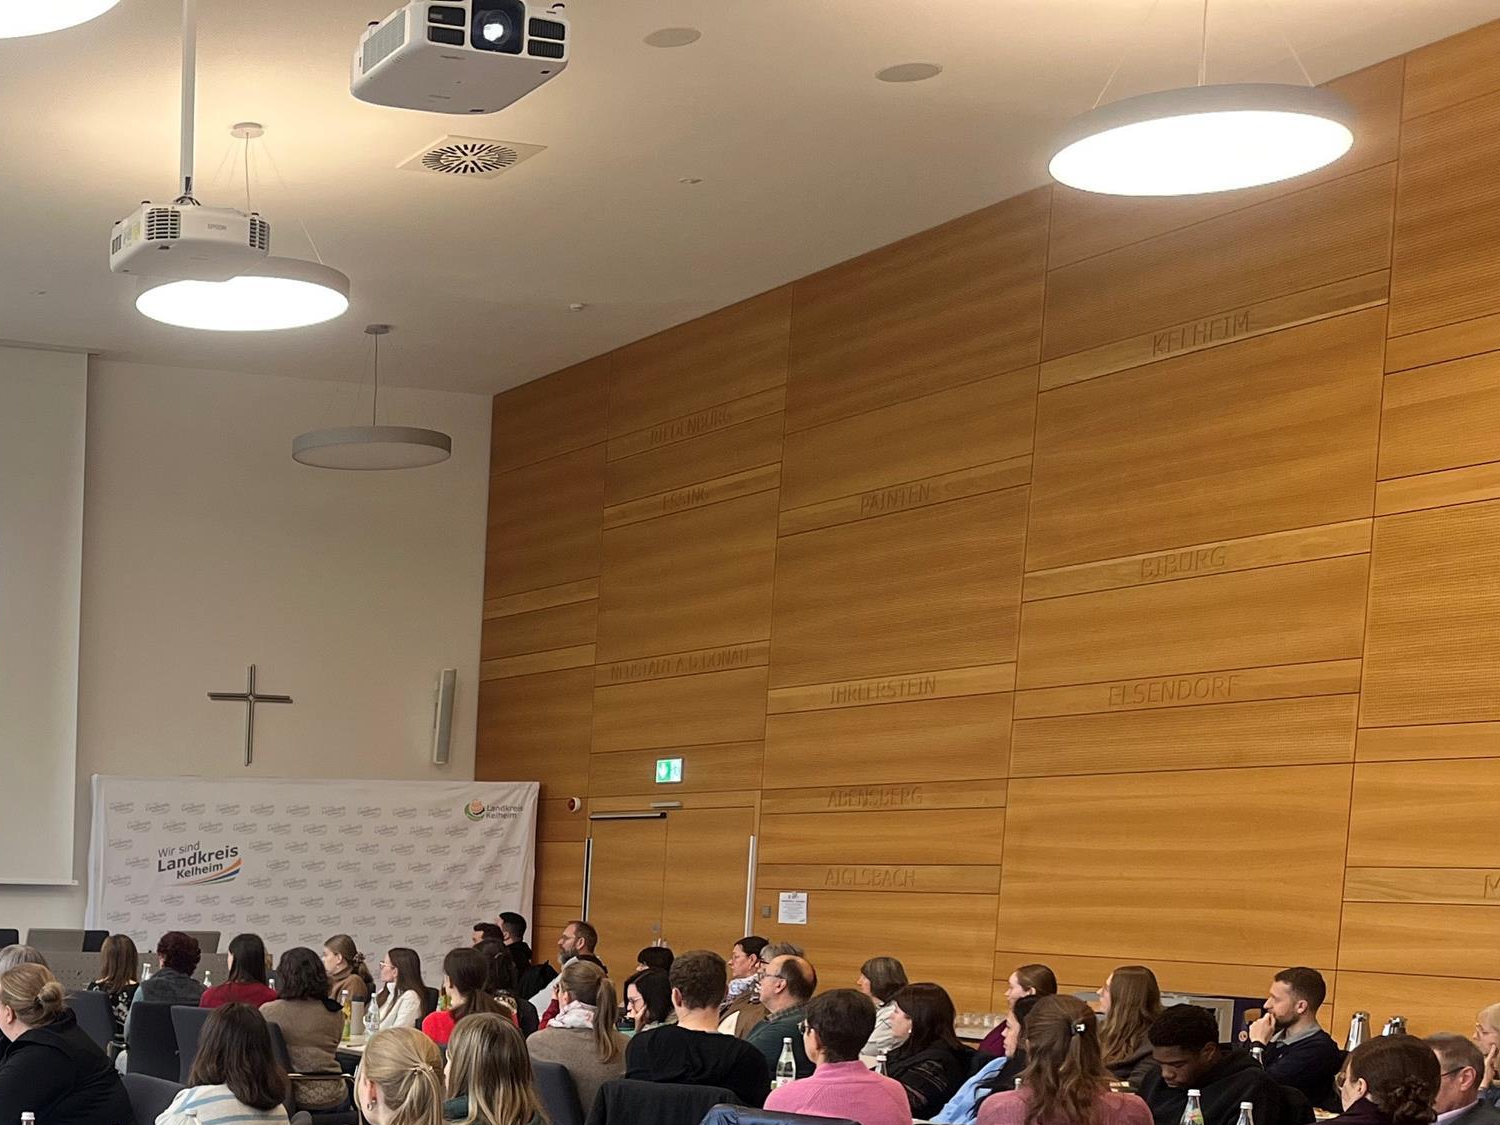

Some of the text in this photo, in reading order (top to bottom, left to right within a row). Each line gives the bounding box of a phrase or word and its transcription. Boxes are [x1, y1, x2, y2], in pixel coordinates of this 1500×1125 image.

[1152, 310, 1250, 357] KELHEIM
[1140, 546, 1227, 578] BIBURG
[1108, 675, 1242, 706] ELSENDORF
[486, 804, 523, 812] Landkreis
[157, 845, 239, 872] Landkreis
[158, 841, 200, 858] Wir sind
[176, 863, 224, 879] Kelheim
